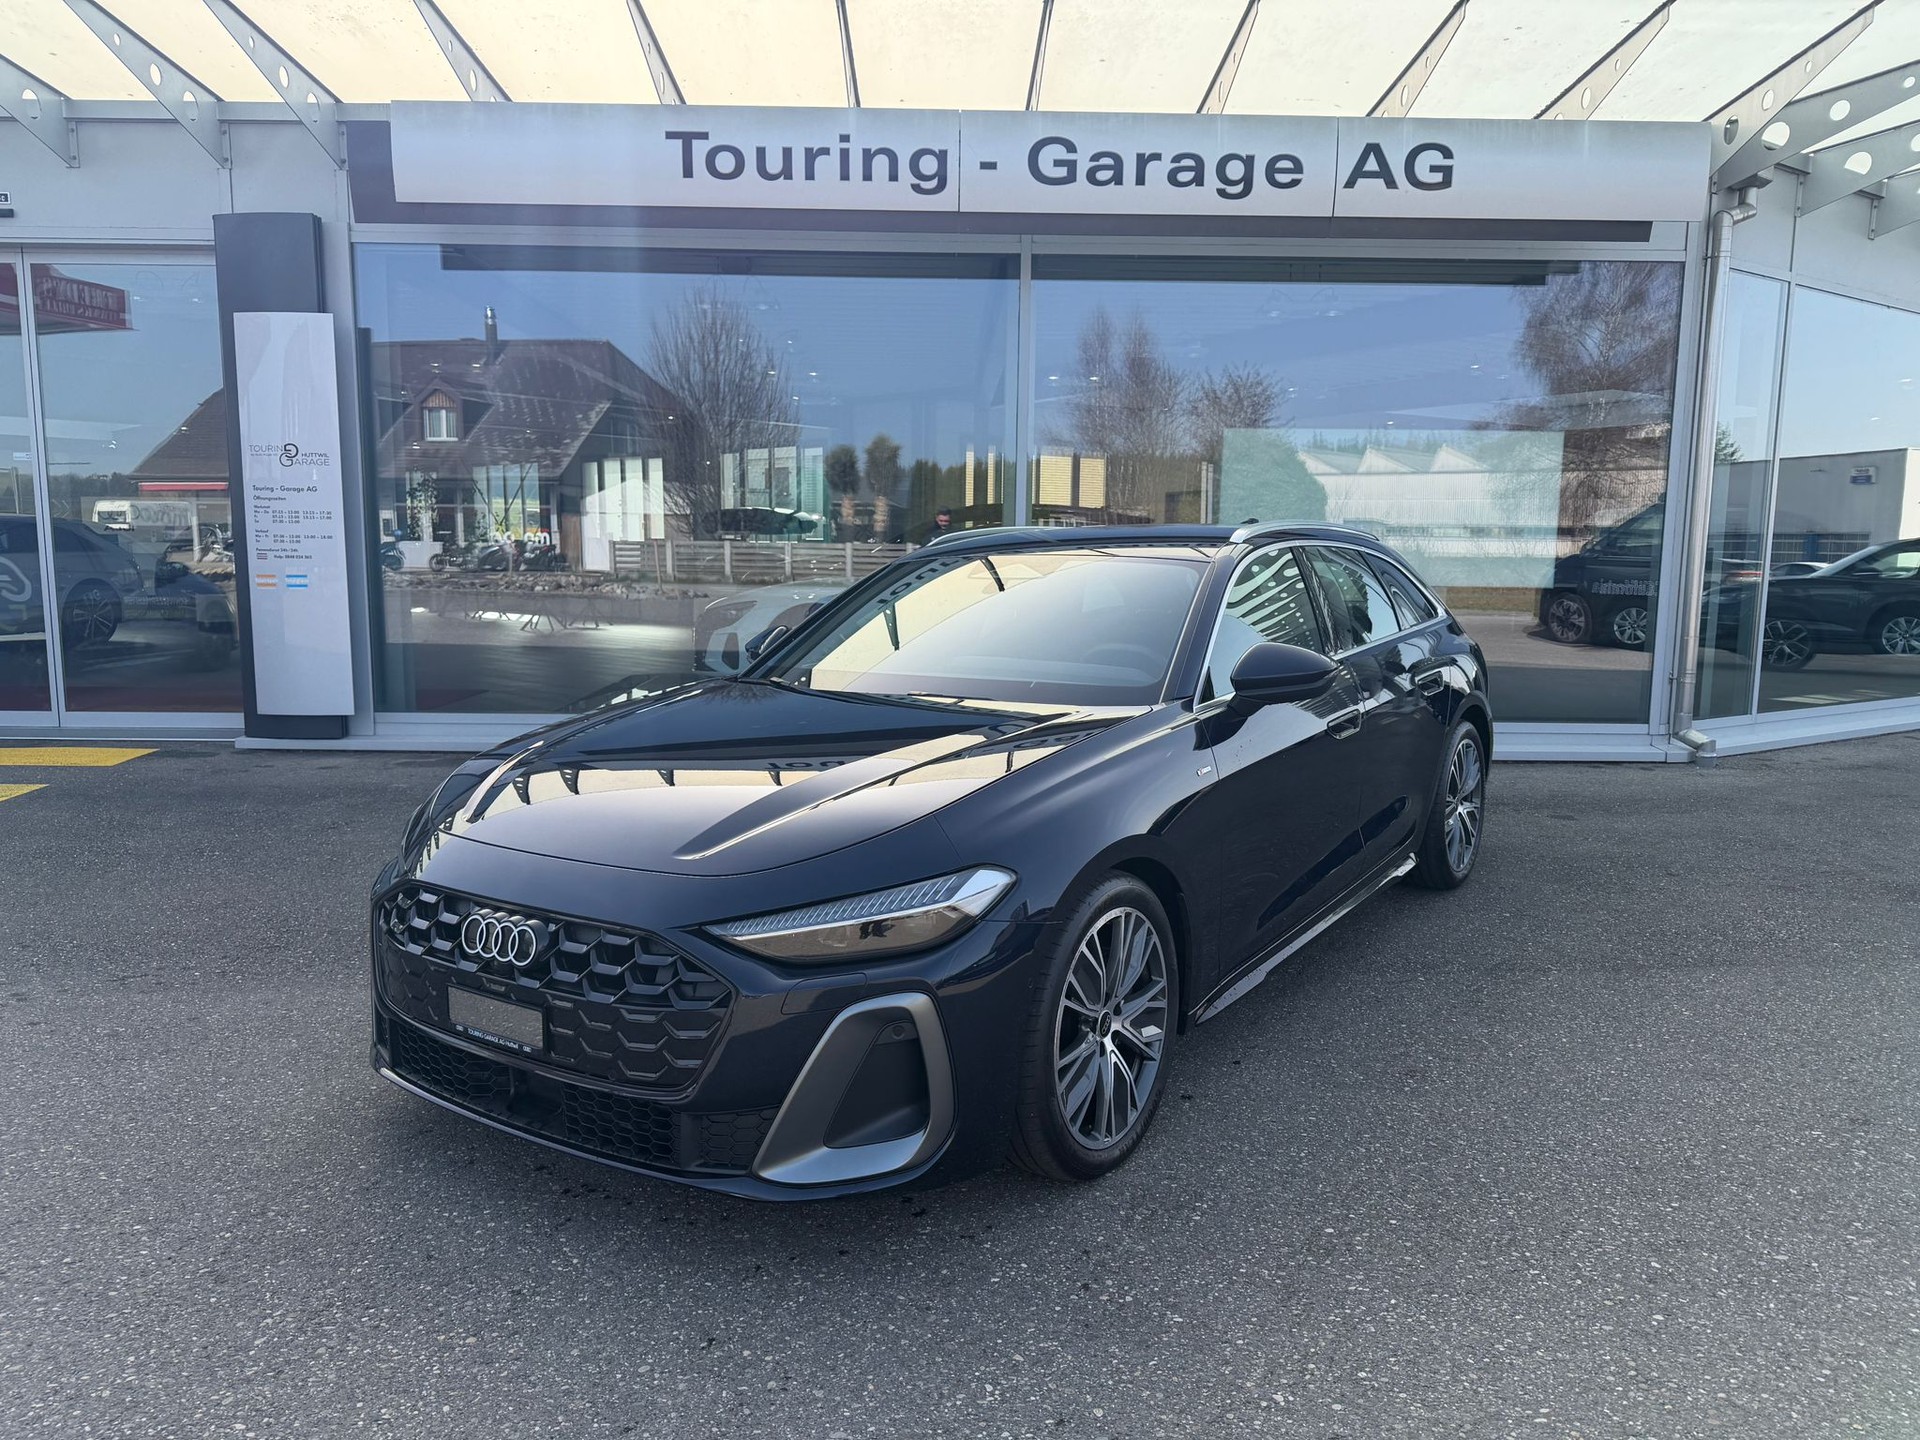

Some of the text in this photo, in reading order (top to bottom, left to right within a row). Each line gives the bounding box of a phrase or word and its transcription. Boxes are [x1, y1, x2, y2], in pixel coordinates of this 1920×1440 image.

[665, 130, 1456, 200] Touring - Garage AG
[279, 452, 330, 467] GARAGE
[252, 484, 274, 493] Touring
[280, 485, 304, 493] Garage
